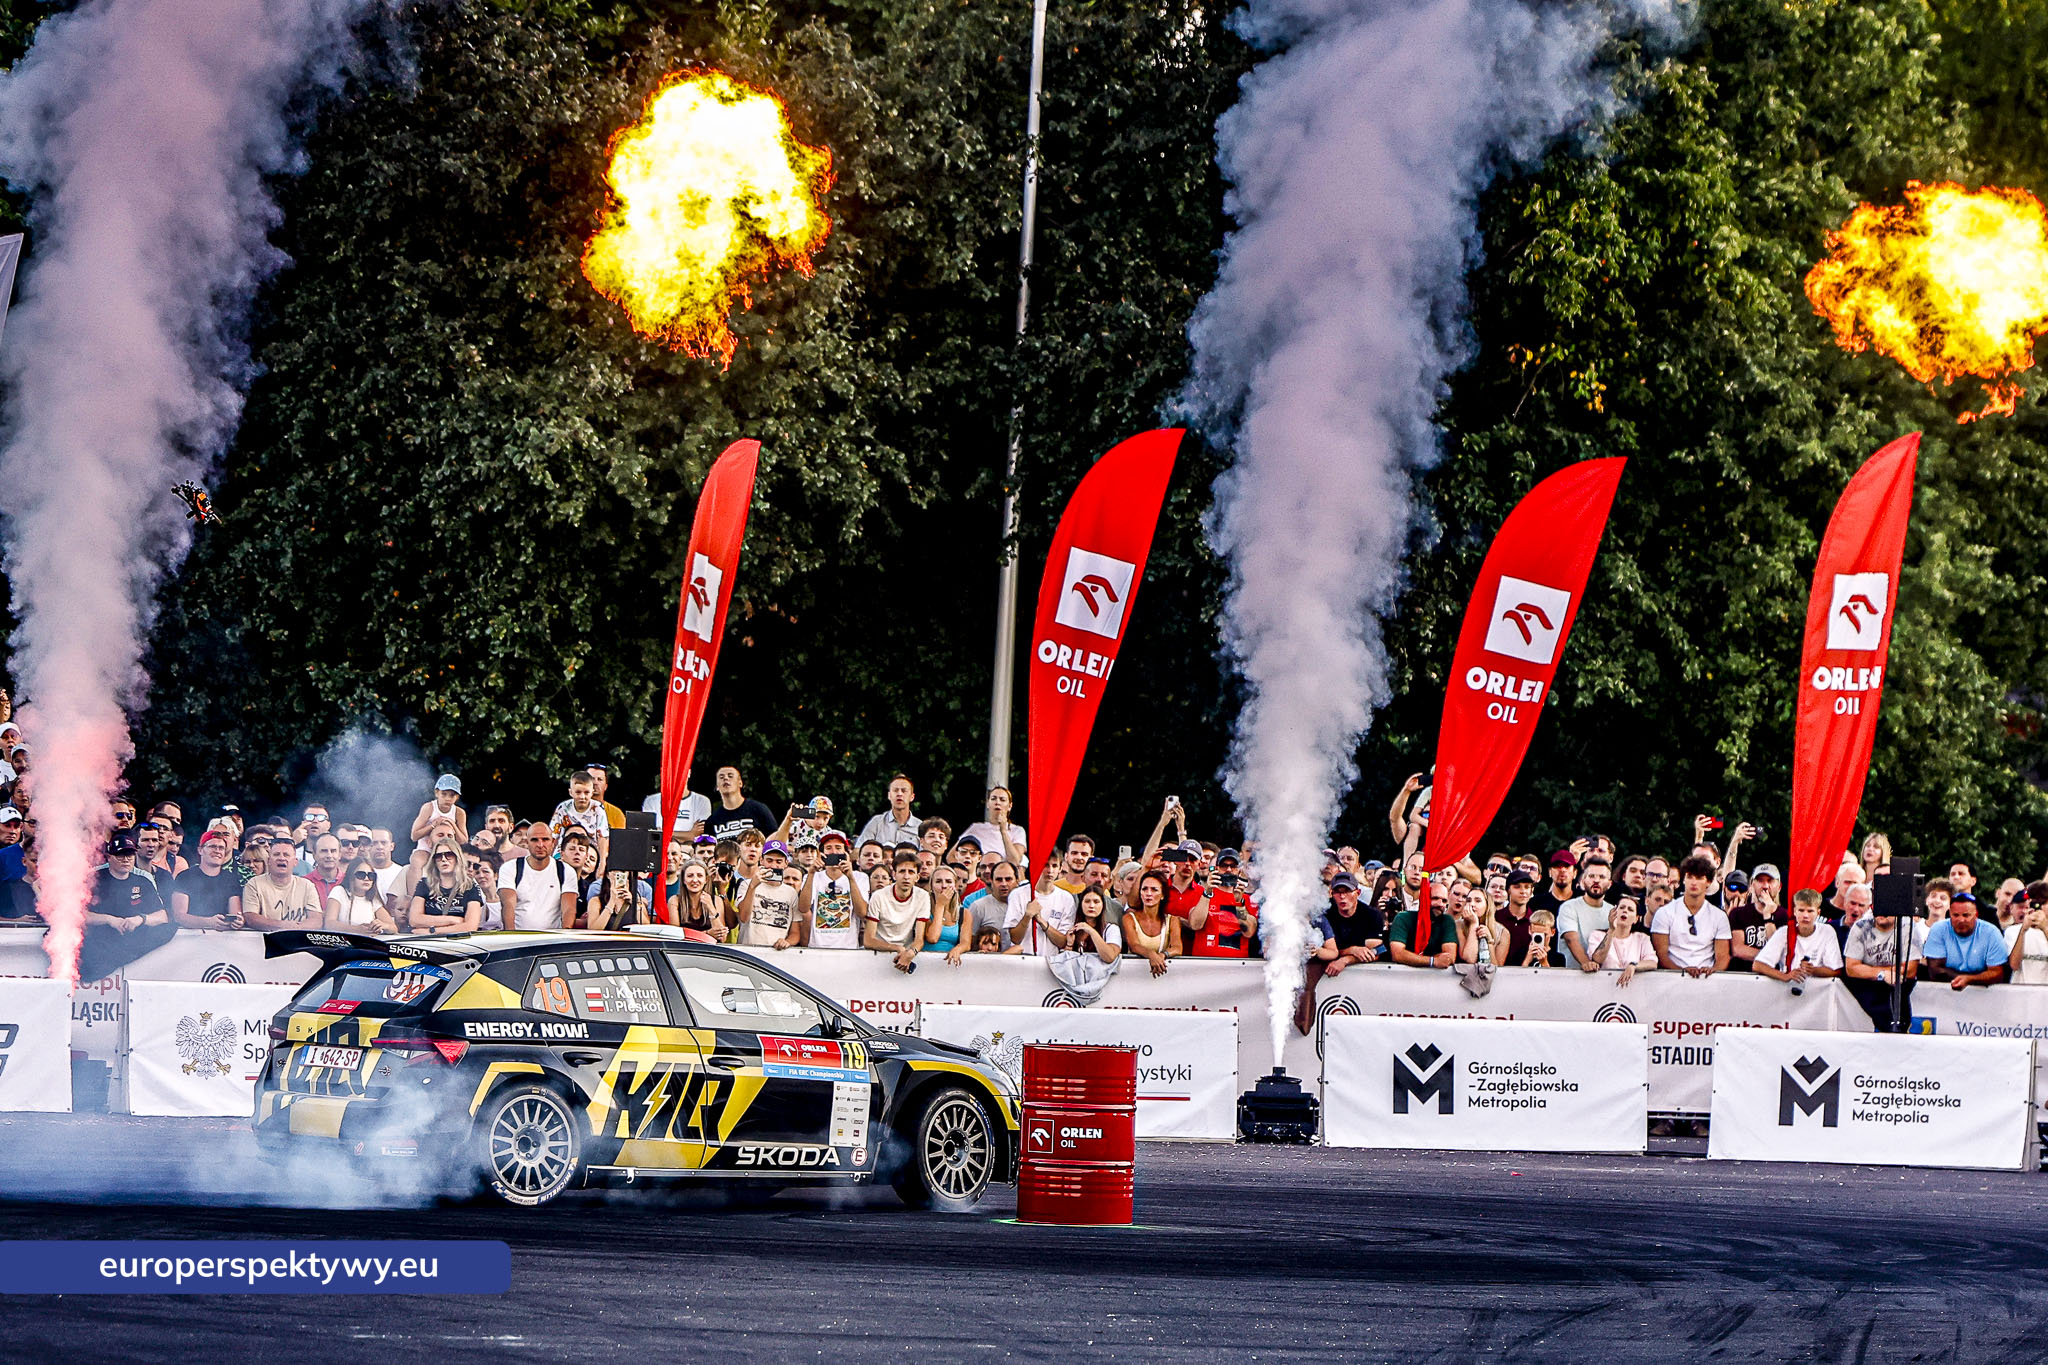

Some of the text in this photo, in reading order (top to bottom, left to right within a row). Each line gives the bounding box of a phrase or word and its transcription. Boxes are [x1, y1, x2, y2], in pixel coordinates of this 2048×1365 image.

[1056, 675, 1086, 699] OIL
[1487, 702, 1519, 724] OIL
[1834, 696, 1860, 715] OIL
[535, 977, 571, 1013] 19
[615, 1001, 662, 1013] Pleskot
[463, 1022, 590, 1038] ENERGY. NOW!
[800, 1044, 828, 1053] ORLEN
[843, 1042, 866, 1069] 19
[810, 1070, 845, 1080] Championship
[1468, 1062, 1557, 1078] Górnośląsko
[1853, 1075, 1941, 1092] Górnośląsko
[1468, 1096, 1547, 1112] Metropolia
[1852, 1109, 1930, 1126] Metropolia
[1060, 1127, 1102, 1139] ORLEN
[1060, 1140, 1076, 1148] OIL
